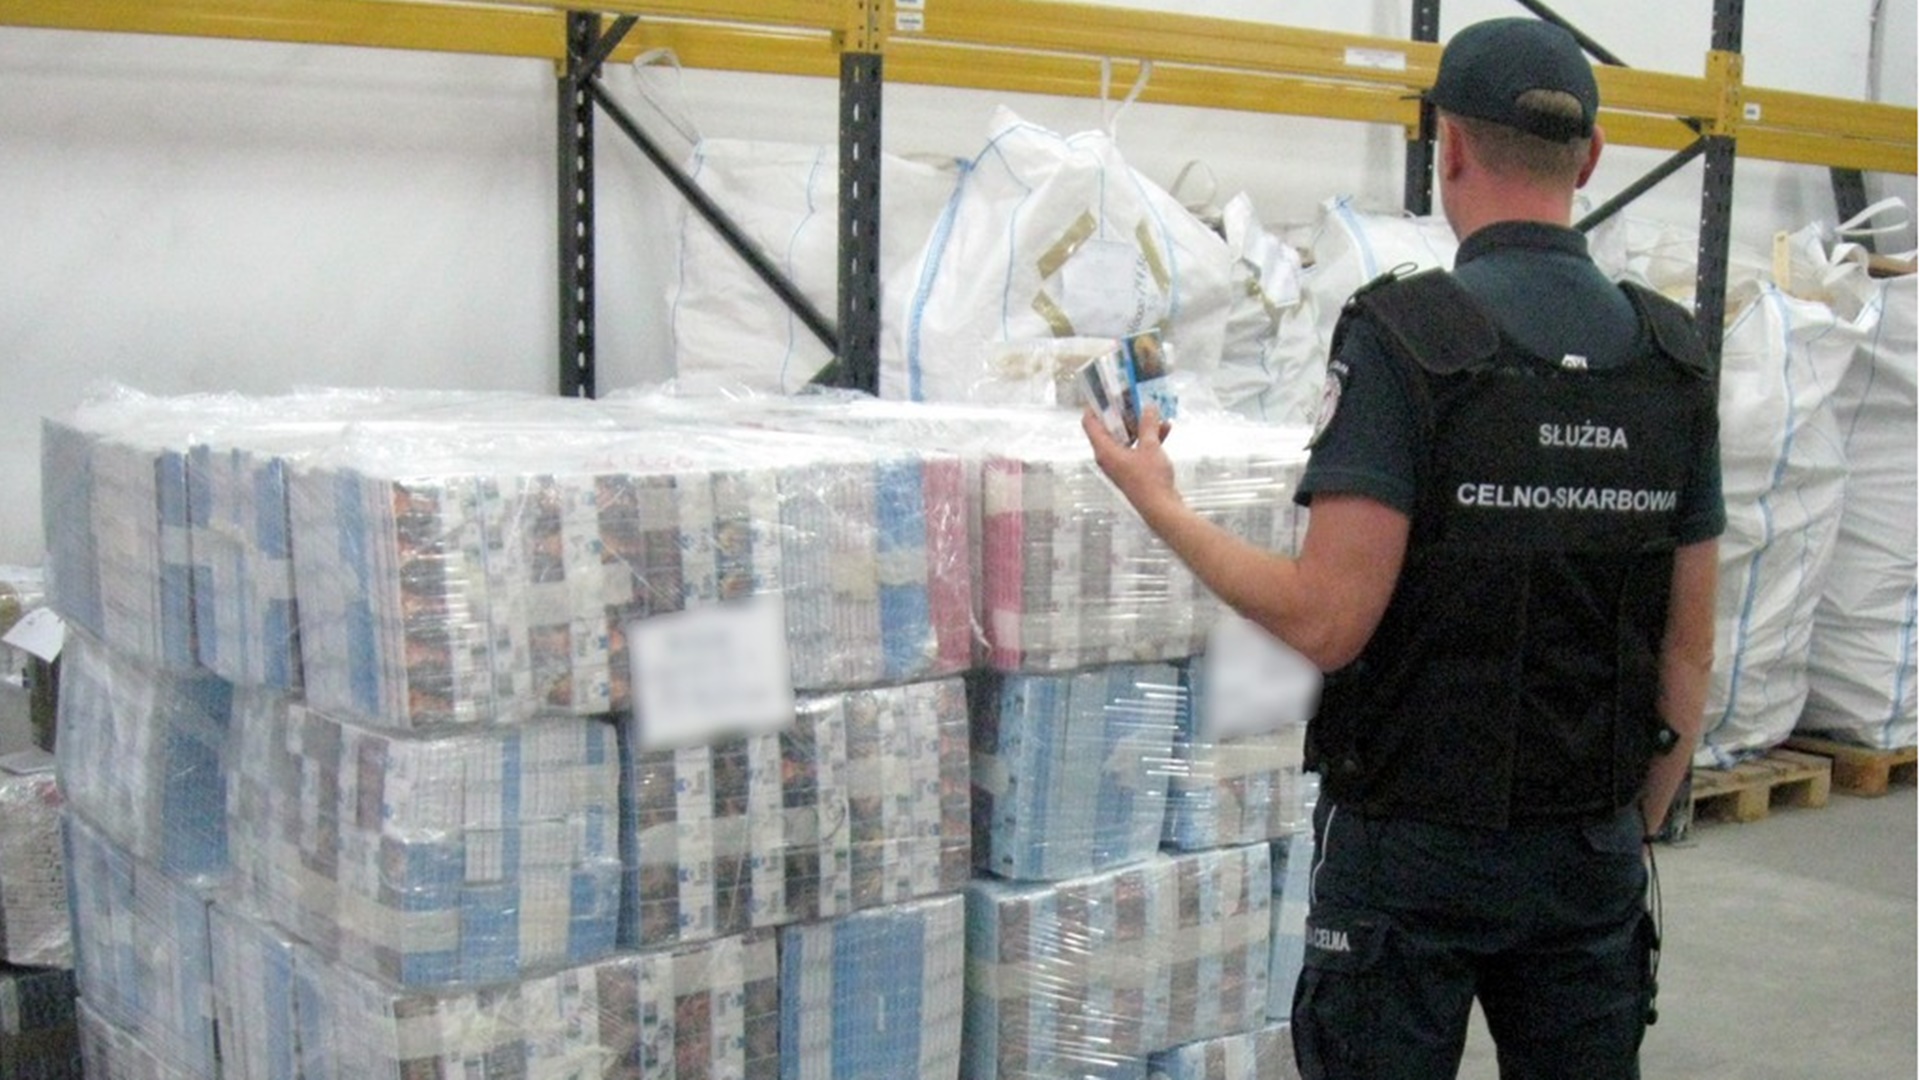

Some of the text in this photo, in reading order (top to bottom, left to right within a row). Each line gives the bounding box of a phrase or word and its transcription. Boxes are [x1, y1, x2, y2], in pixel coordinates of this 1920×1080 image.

[1539, 419, 1629, 450] SŁUŻBA
[1456, 482, 1678, 511] CELNO-SKARBOWA
[1314, 927, 1351, 952] CELNA
